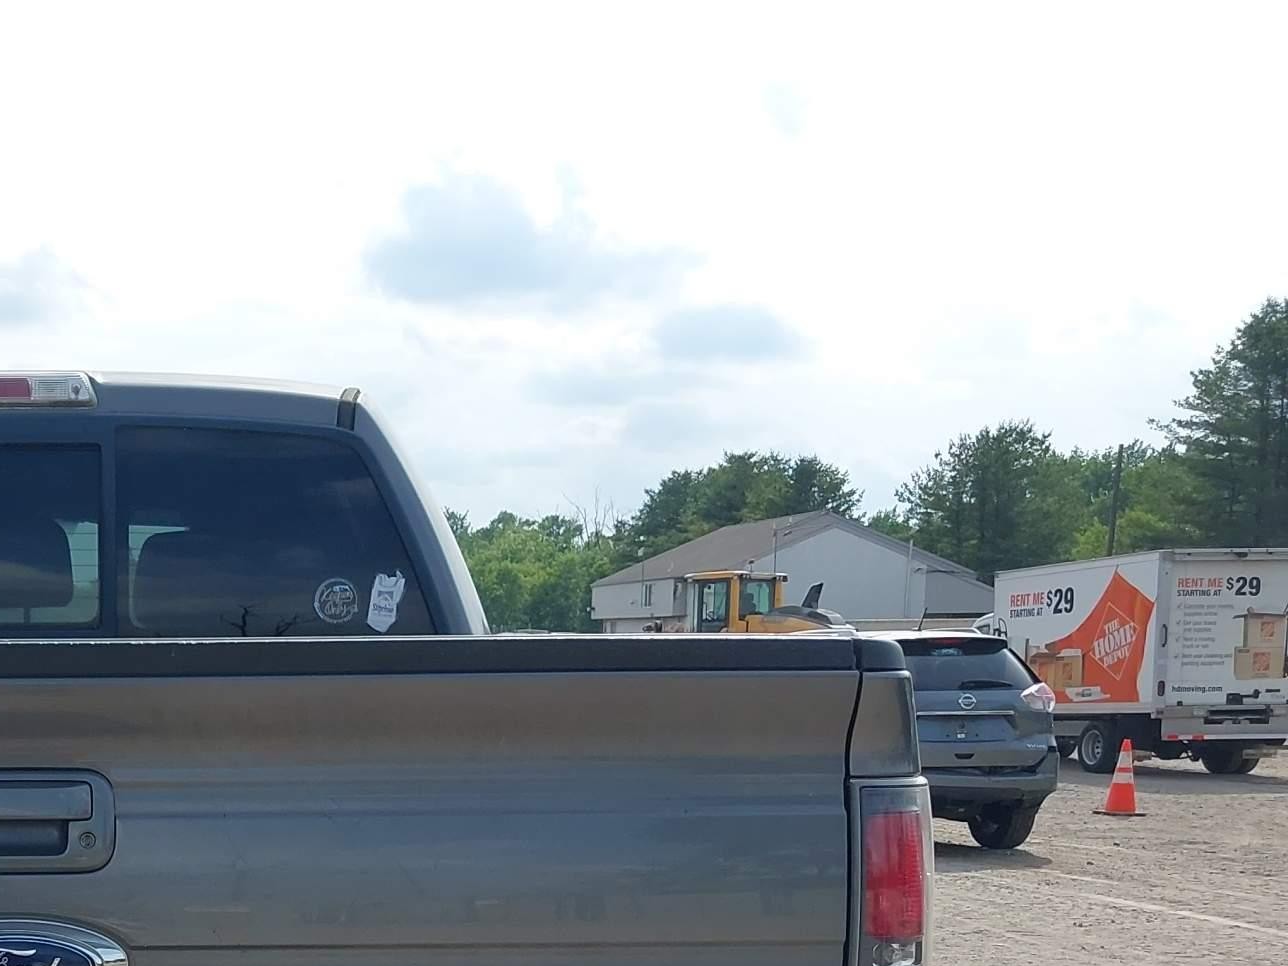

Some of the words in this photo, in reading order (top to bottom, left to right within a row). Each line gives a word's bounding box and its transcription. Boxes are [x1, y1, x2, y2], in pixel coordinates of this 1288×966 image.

[1177, 578, 1205, 588] RENT
[1208, 577, 1224, 588] ME
[1226, 576, 1261, 596] $29
[1177, 589, 1211, 597] STARTING
[1213, 589, 1222, 597] AT
[1010, 593, 1031, 608] RENT
[1032, 591, 1045, 605] ME
[1046, 586, 1074, 615] $29
[1009, 608, 1035, 619] STARTING
[1036, 607, 1043, 617] AT
[1103, 618, 1120, 635] THE
[1094, 622, 1135, 659] HOME
[1103, 645, 1130, 667] DEPOT
[1171, 686, 1223, 694] hdmoving.com
